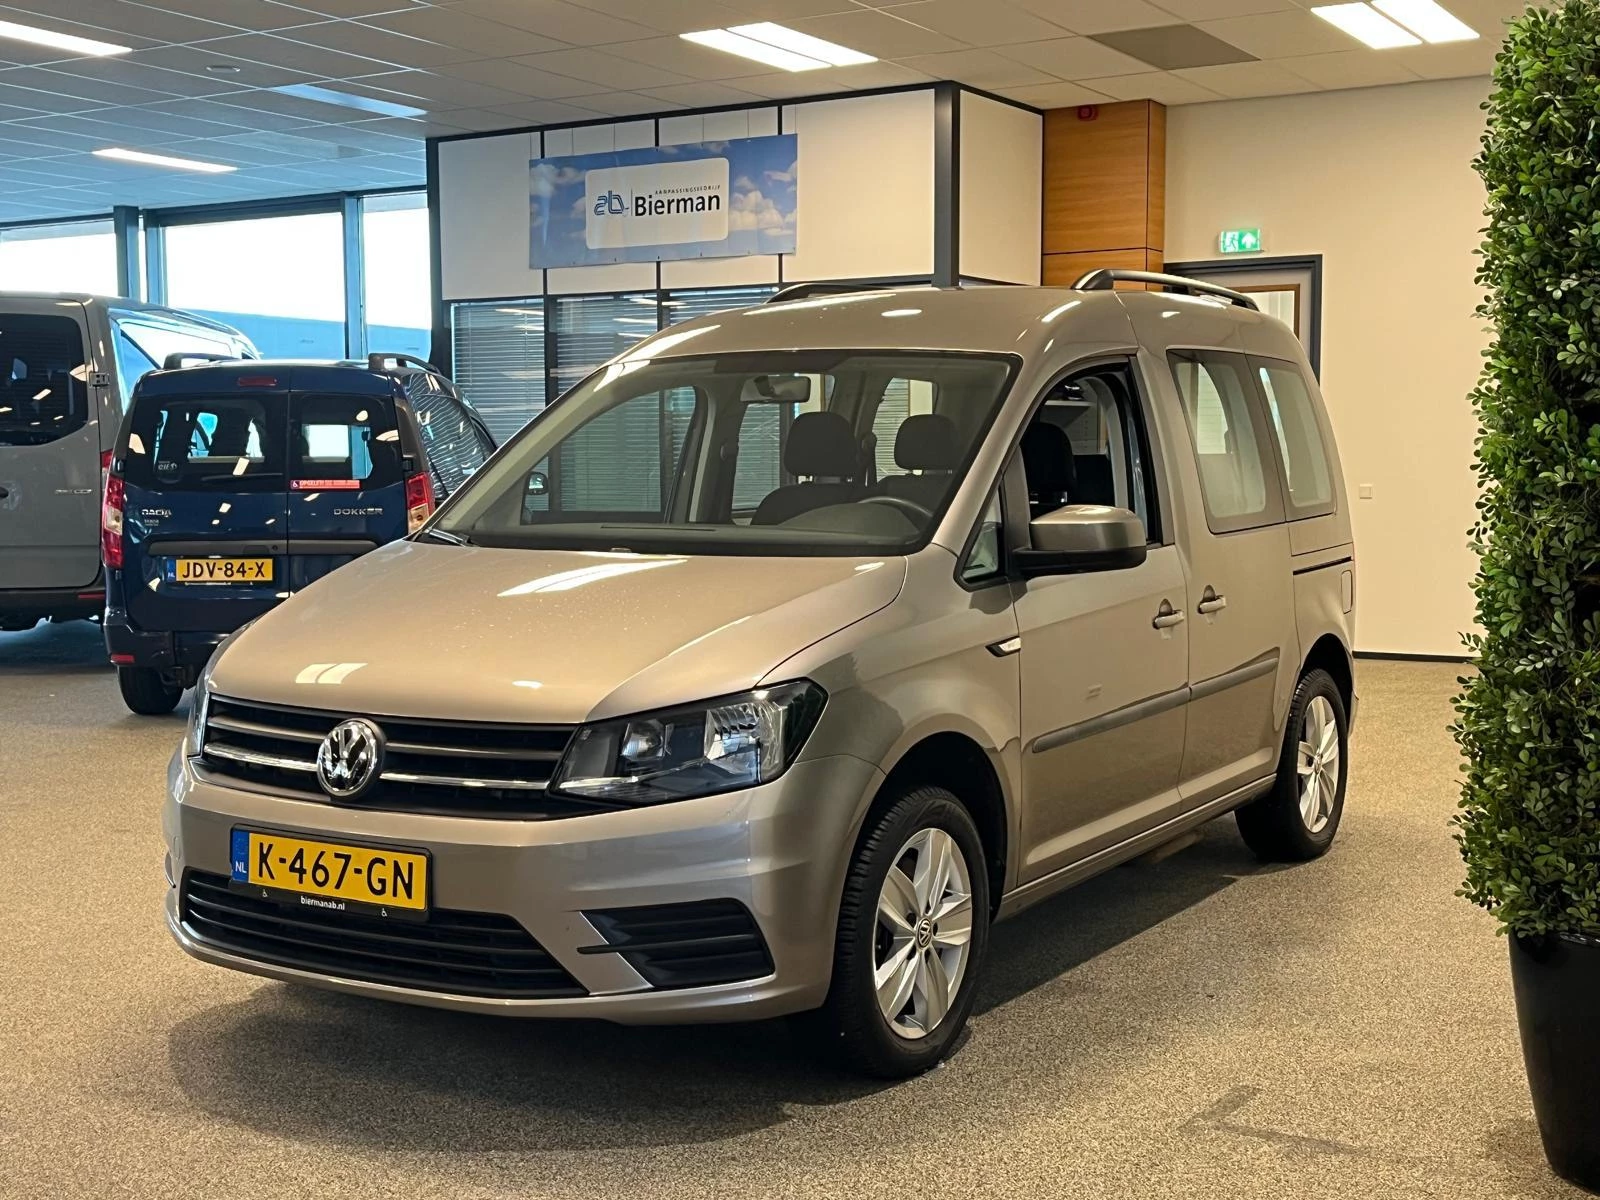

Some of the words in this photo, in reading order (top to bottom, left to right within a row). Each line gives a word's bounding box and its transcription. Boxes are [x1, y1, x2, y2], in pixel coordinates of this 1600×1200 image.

[634, 194, 721, 217] Bierman
[182, 562, 265, 578] JDV-84-X
[235, 861, 248, 874] NL
[257, 842, 414, 900] K-467-GN
[300, 895, 346, 911] biermanab.nl
